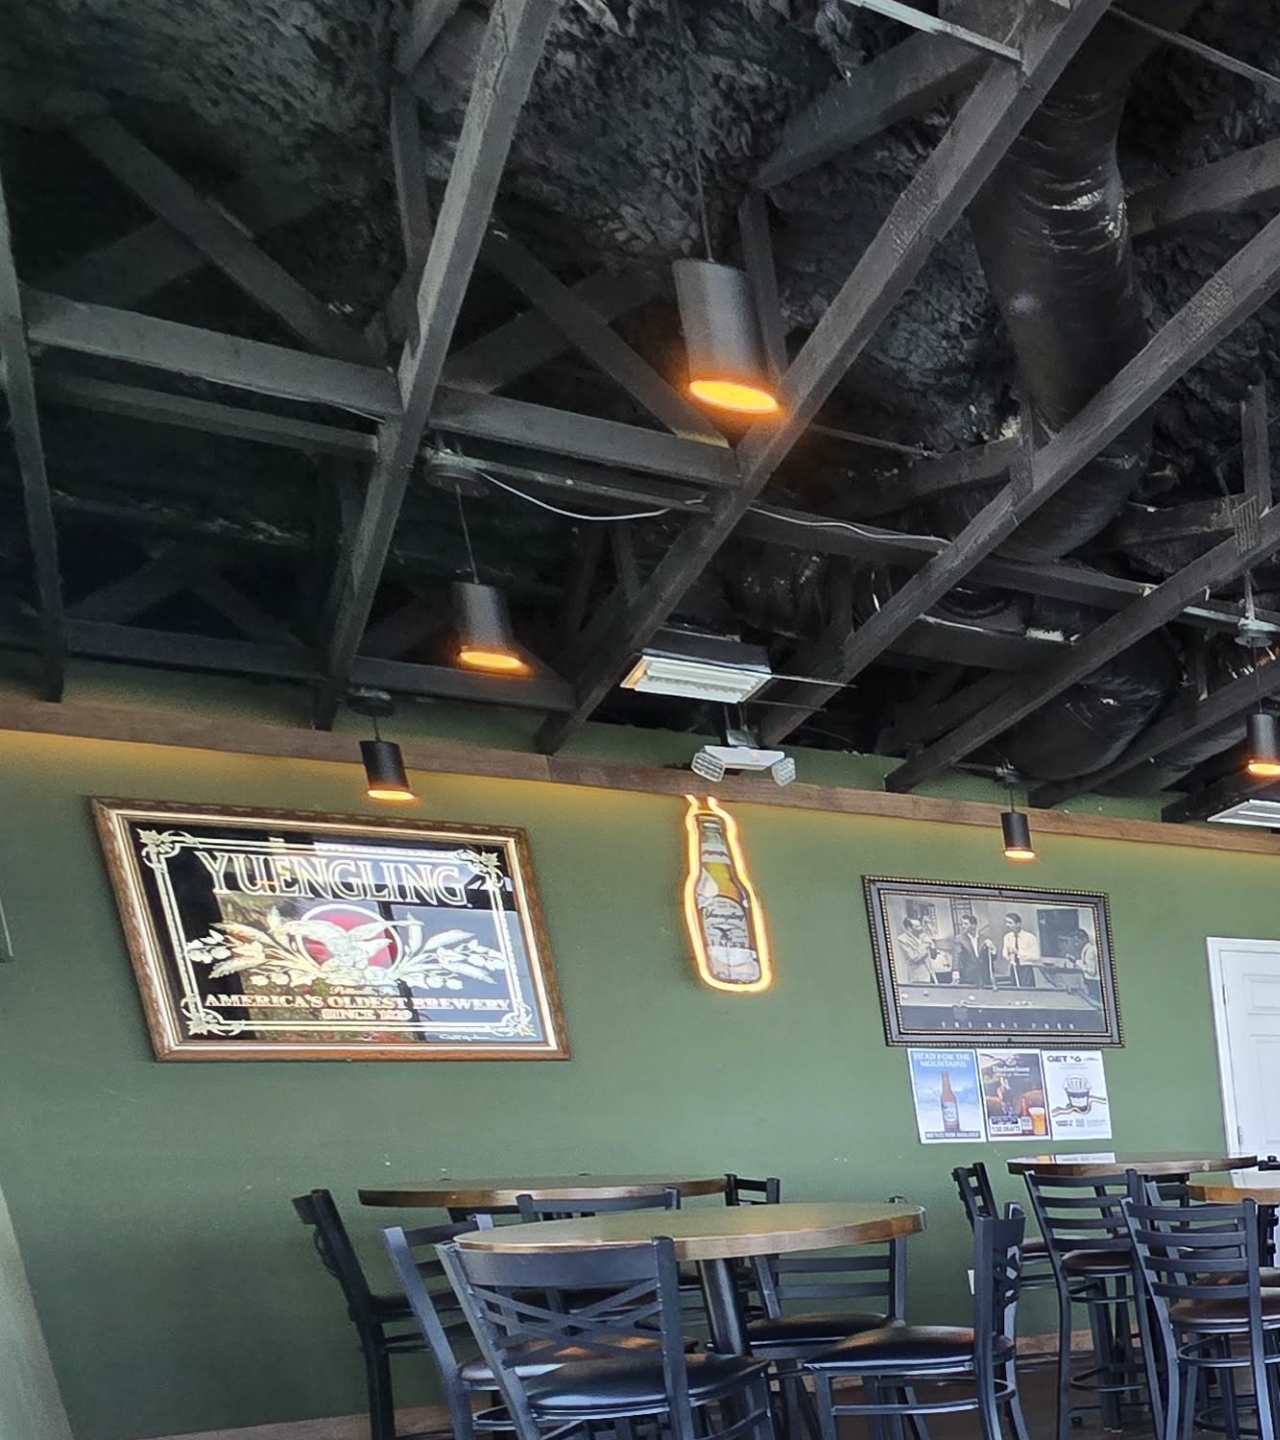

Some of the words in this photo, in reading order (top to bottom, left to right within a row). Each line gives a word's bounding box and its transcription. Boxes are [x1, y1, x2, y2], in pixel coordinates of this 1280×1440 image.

[195, 851, 469, 906] YUENGLING
[205, 994, 324, 1008] AMERICA'S
[327, 996, 407, 1009] OLDEST
[414, 997, 510, 1011] BREWERY
